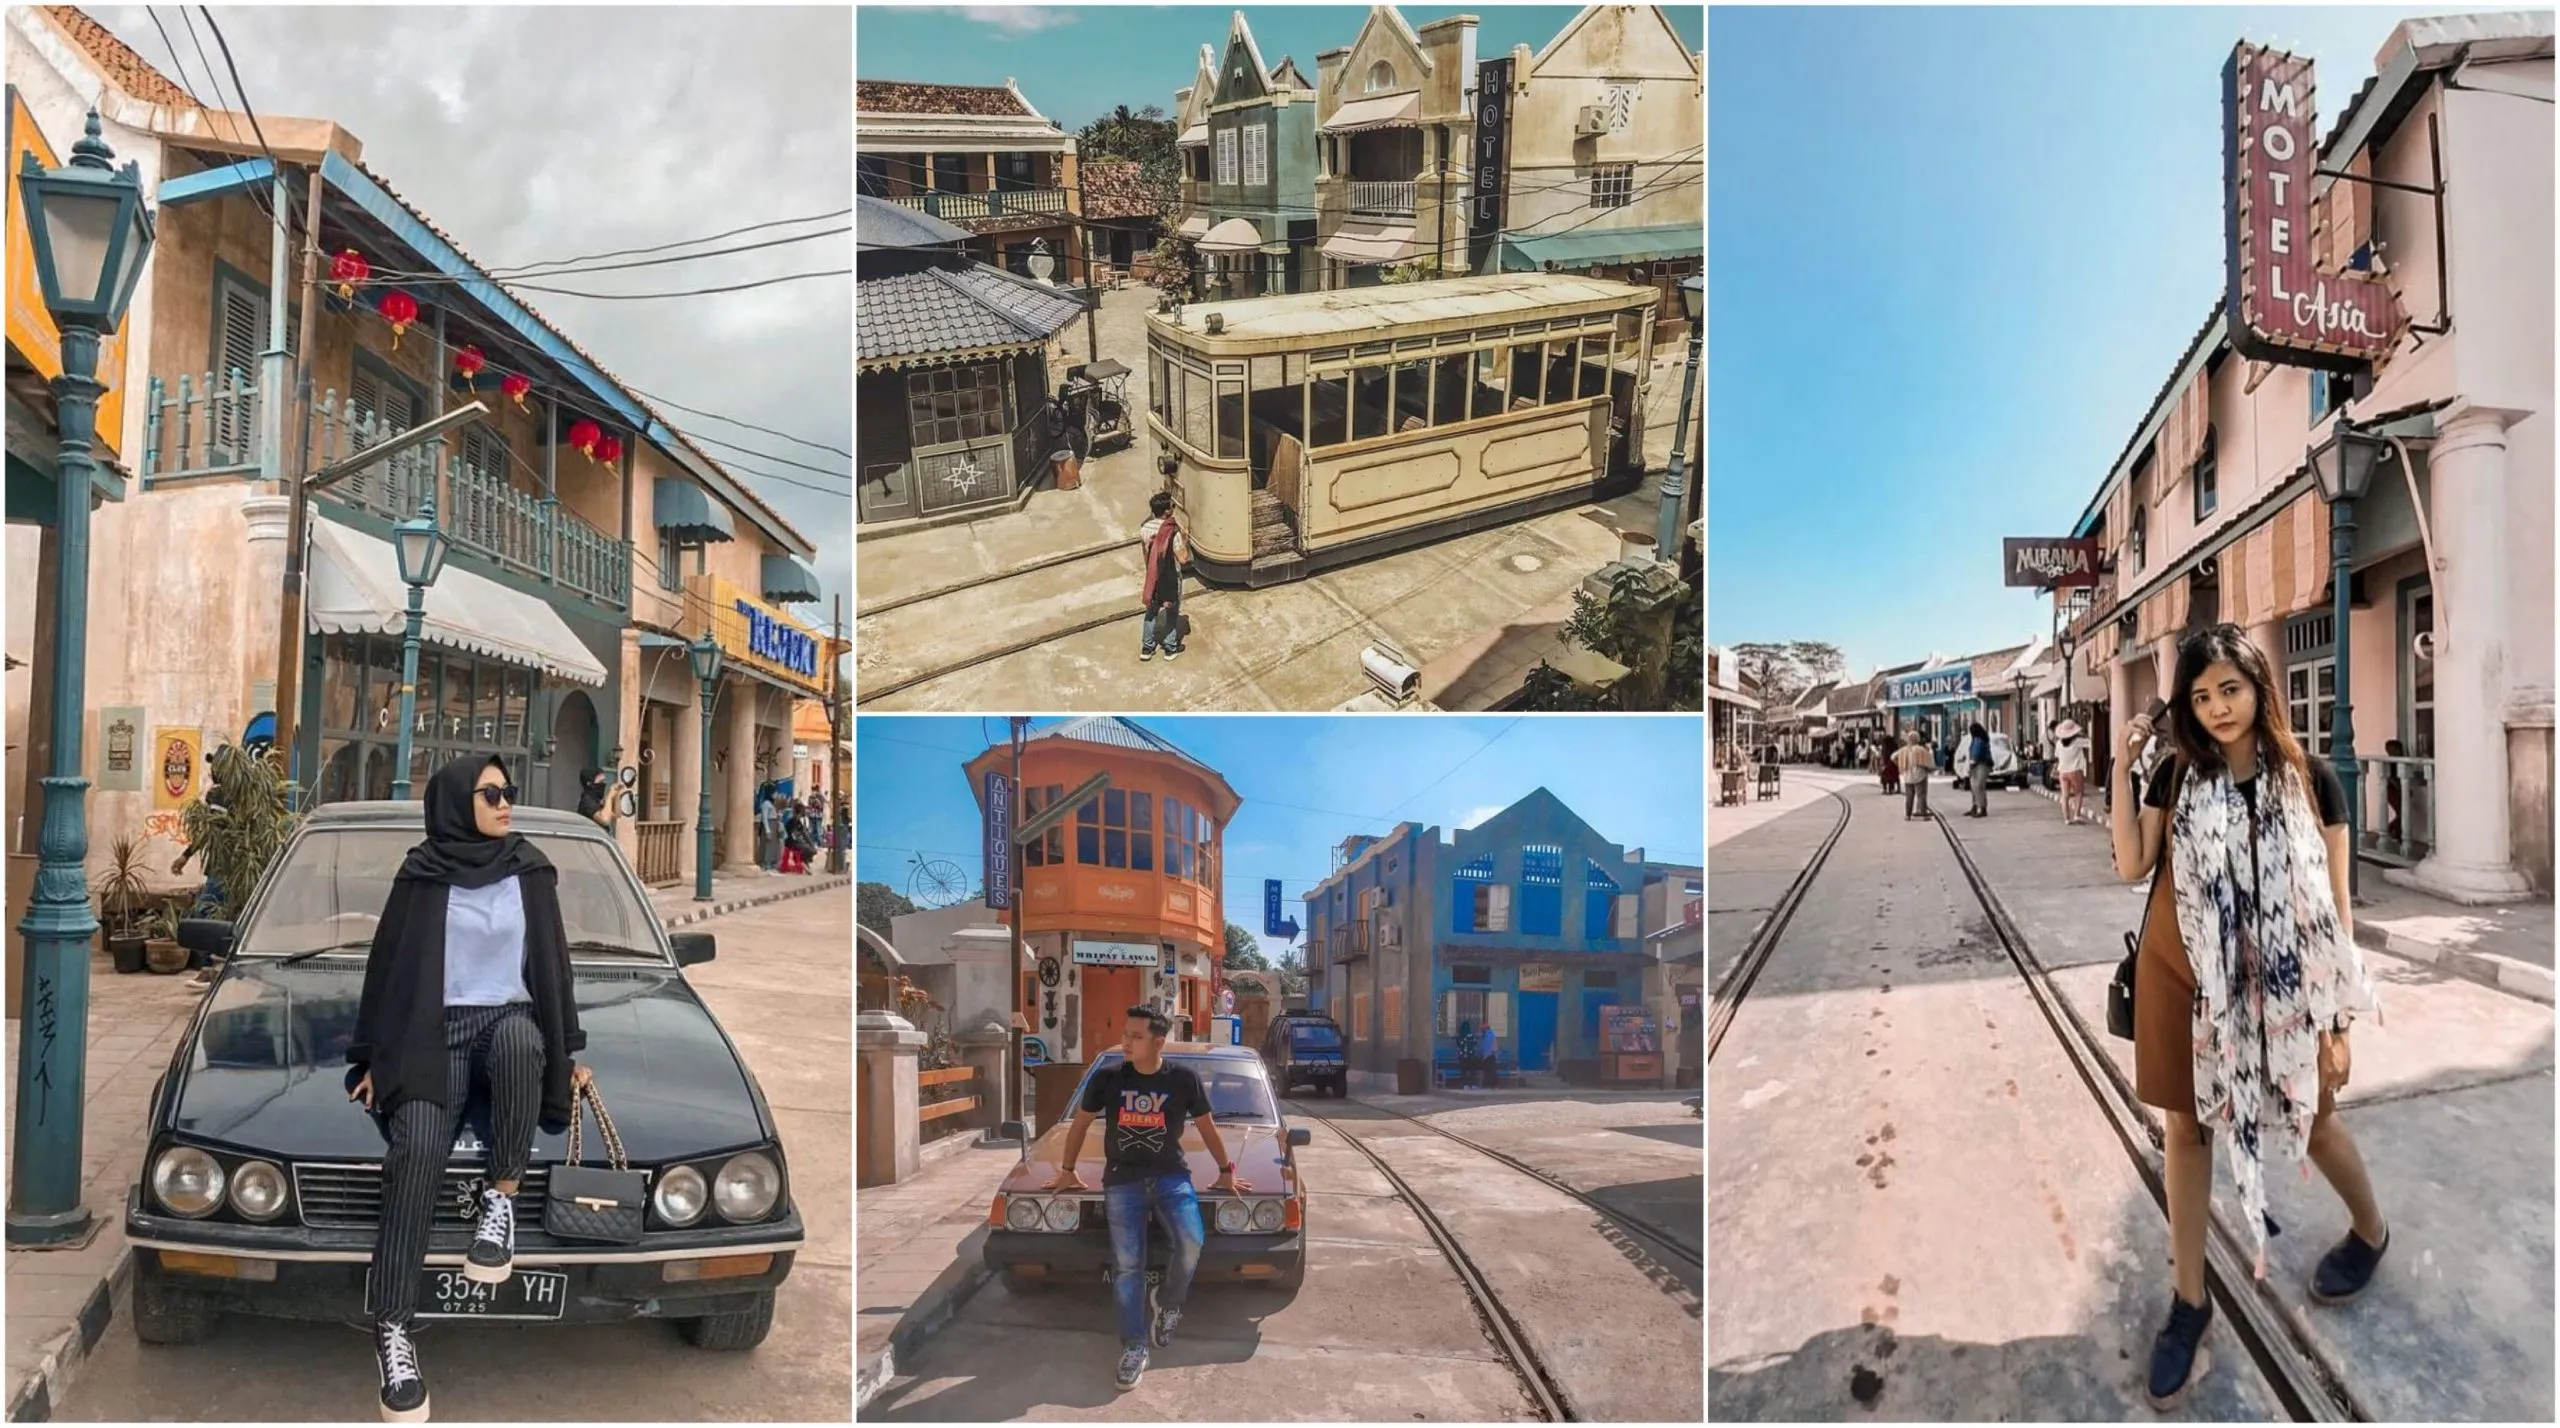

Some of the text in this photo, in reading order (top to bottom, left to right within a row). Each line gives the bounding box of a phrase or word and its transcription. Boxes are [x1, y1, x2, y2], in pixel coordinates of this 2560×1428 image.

[1480, 70, 1499, 219] HOTEL
[2260, 78, 2296, 300] MOTEL
[2293, 281, 2387, 336] Asia
[2016, 547, 2090, 574] MIRAMA
[1904, 676, 1952, 697] RADJIN
[380, 707, 492, 738] CAFE
[993, 778, 1005, 905] ANTIQUES
[1270, 886, 1278, 929] MOTEL
[1122, 953, 1156, 962] LAWAS
[1121, 1090, 1168, 1113] TOY
[523, 1275, 555, 1302] YH
[443, 1302, 486, 1312] 07.25
